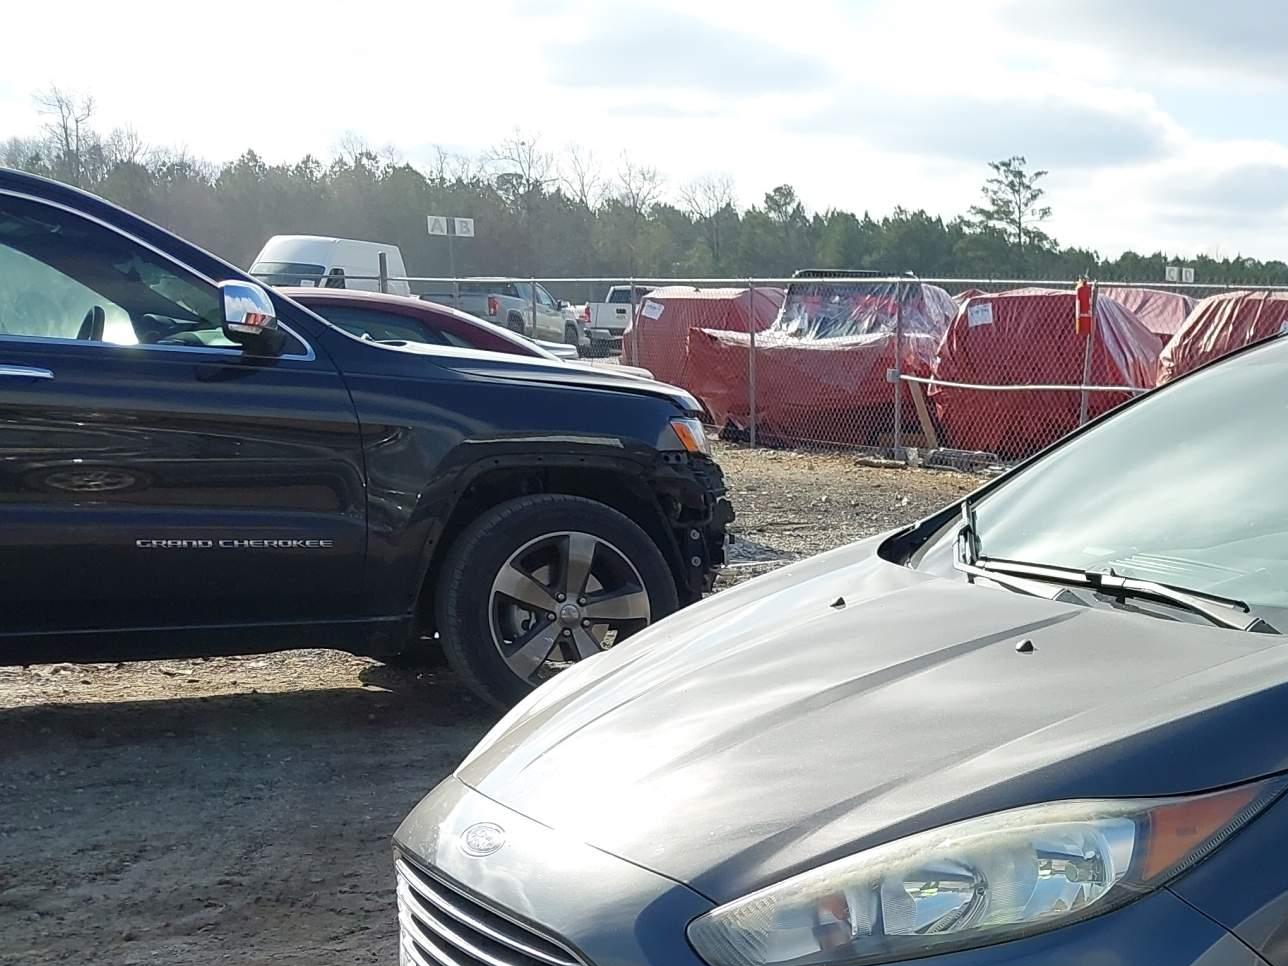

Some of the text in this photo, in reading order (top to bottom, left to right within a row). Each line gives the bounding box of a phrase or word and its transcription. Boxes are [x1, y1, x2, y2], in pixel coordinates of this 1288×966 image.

[430, 218, 445, 234] A
[458, 219, 472, 234] B
[135, 539, 335, 548] GRAND CHEROKEE
